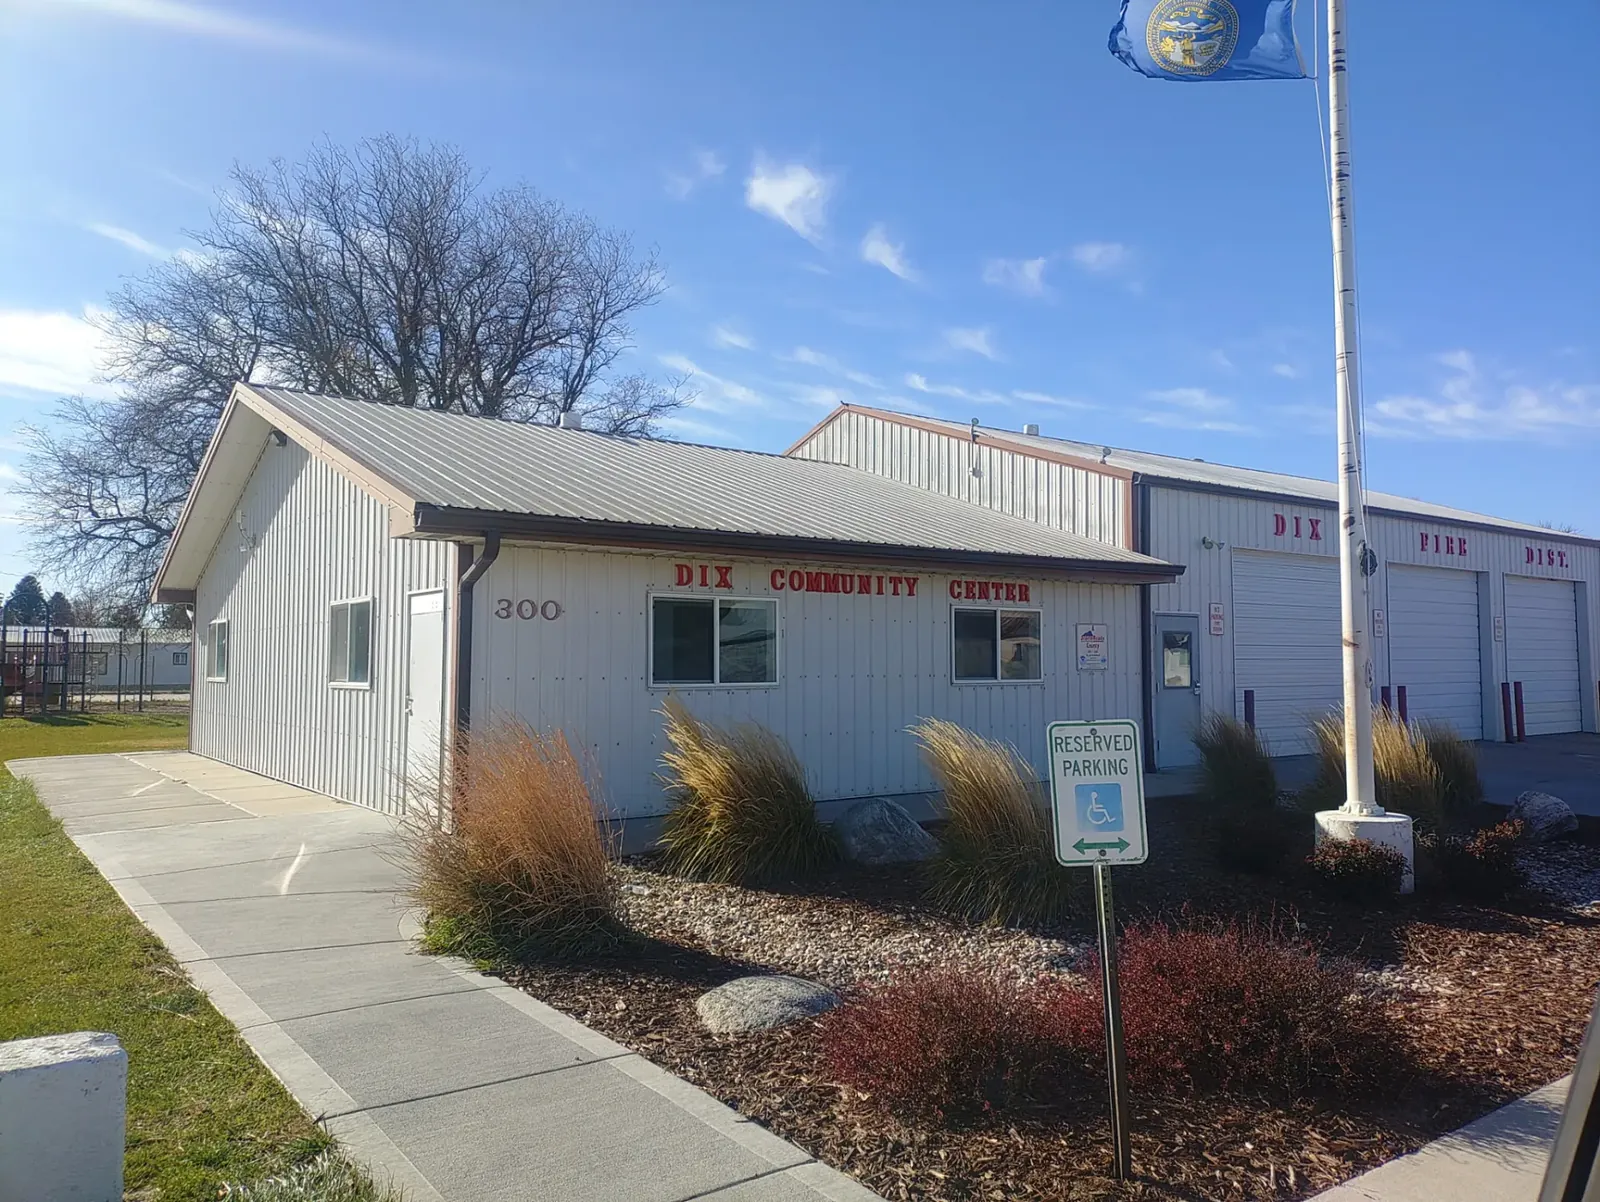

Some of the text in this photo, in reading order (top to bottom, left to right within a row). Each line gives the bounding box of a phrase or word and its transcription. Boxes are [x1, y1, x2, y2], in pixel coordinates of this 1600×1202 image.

[1273, 513, 1569, 569] DIX FIRE DIST.
[674, 563, 1031, 602] DIX COMMUNITY CENTER
[494, 598, 562, 621] 300
[1054, 734, 1133, 753] RESERVED
[1062, 758, 1129, 777] PARKING
